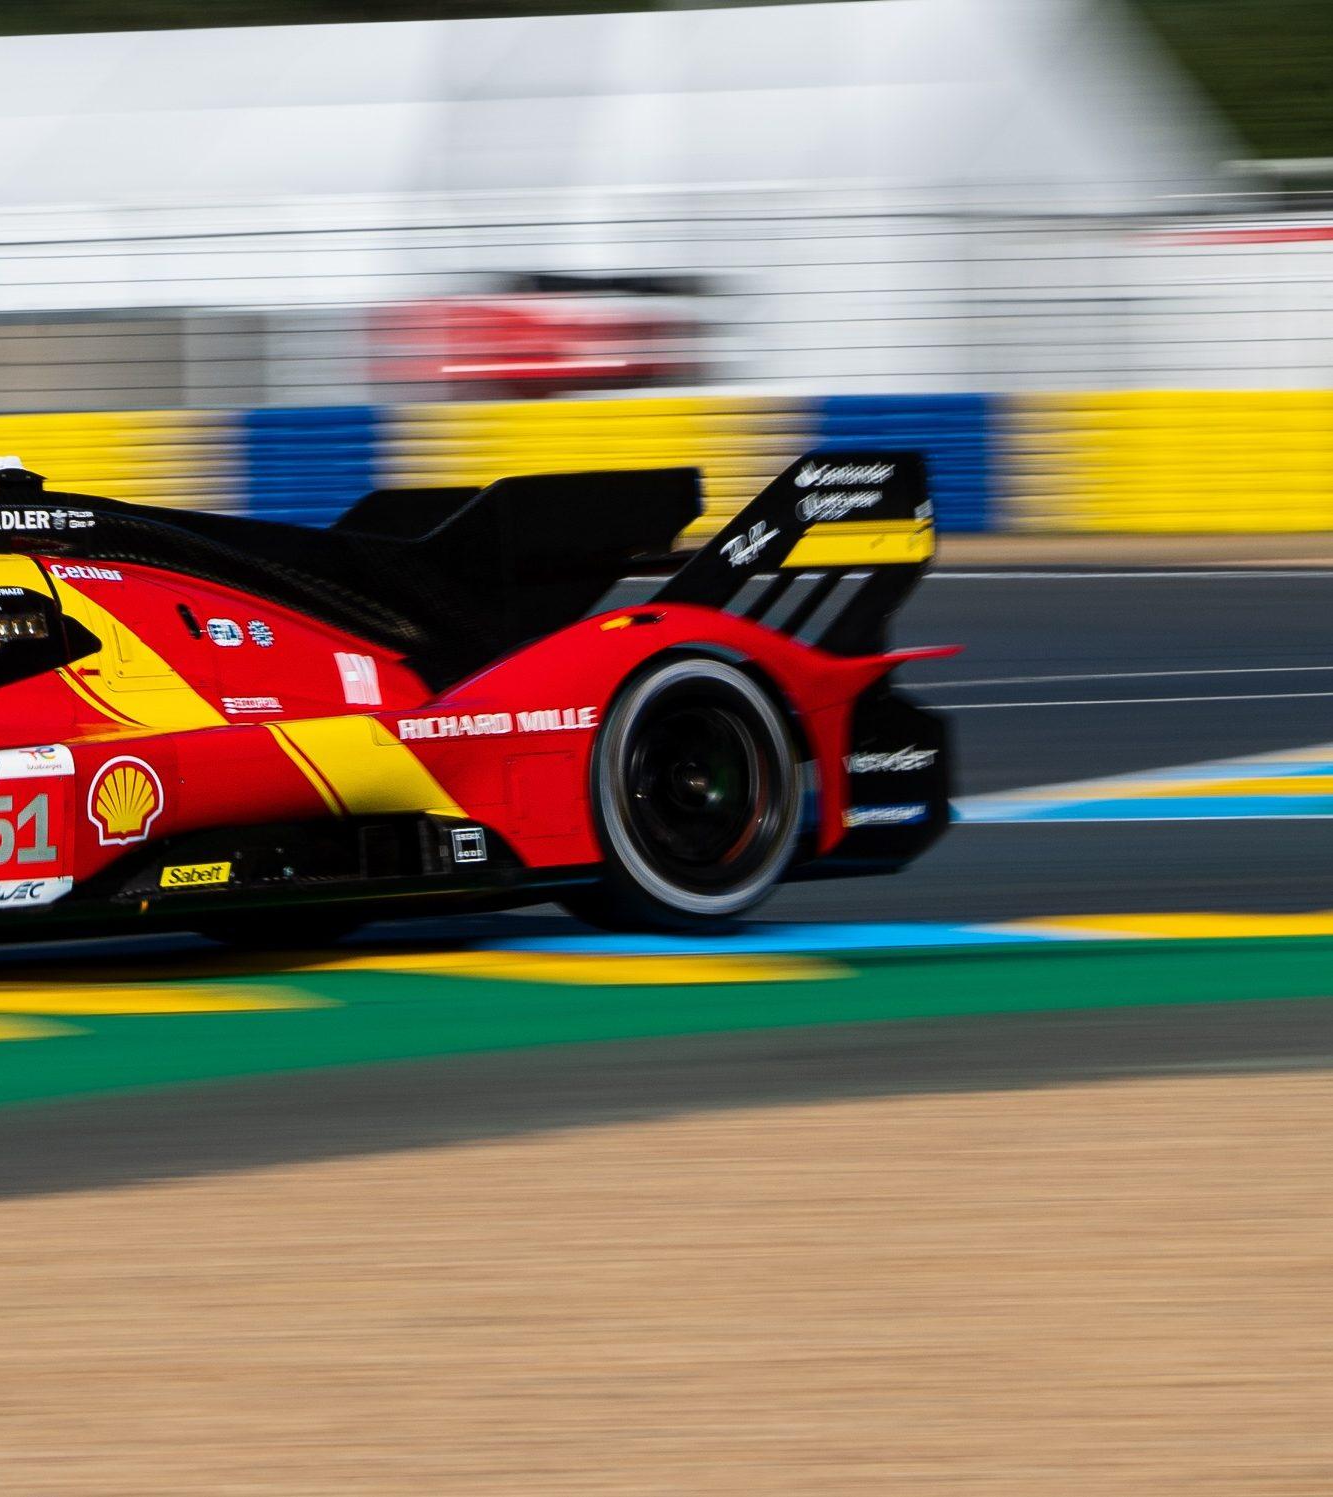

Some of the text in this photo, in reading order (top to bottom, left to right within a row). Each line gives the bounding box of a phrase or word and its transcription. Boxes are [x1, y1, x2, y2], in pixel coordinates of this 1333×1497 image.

[50, 564, 124, 582] Cetilar
[397, 706, 599, 740] RICHARD MILLE
